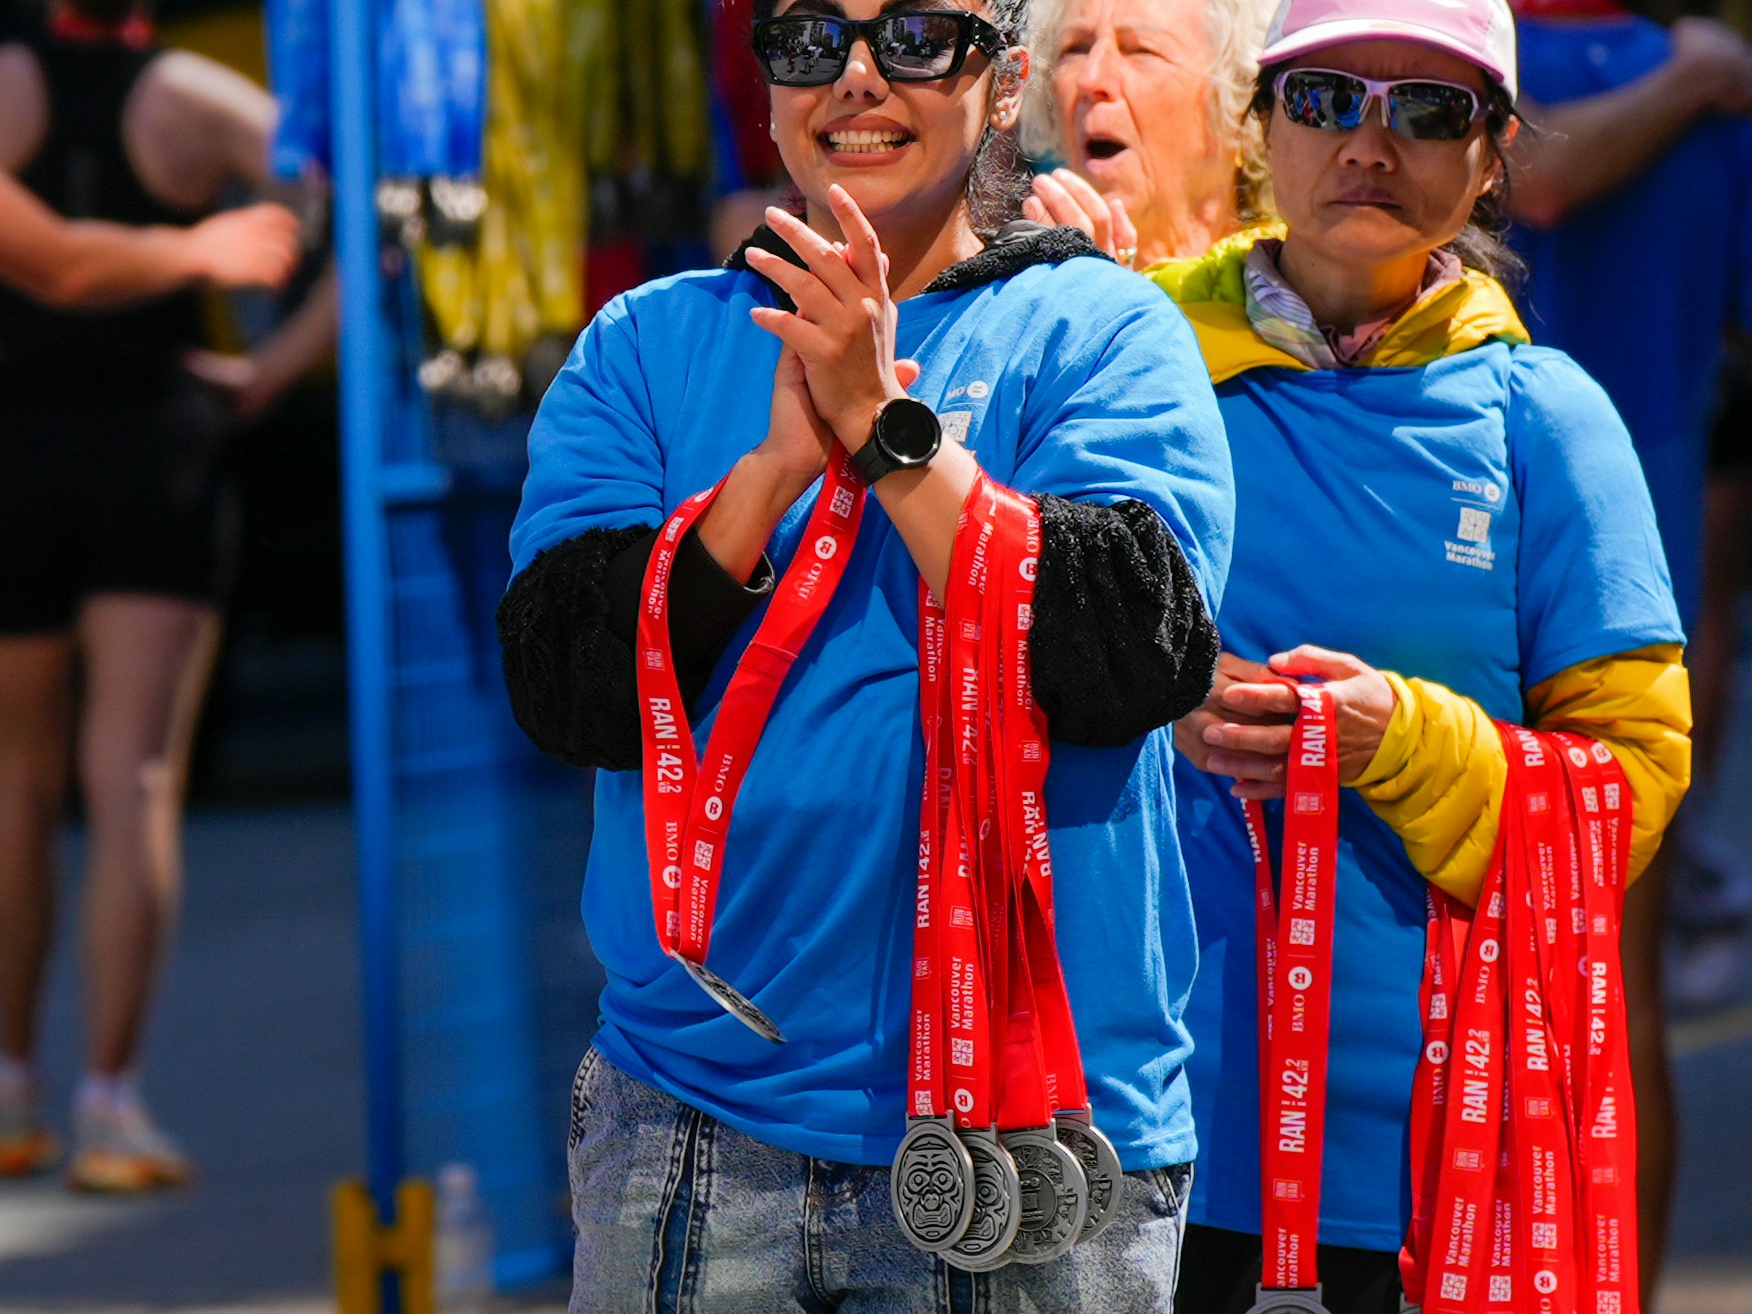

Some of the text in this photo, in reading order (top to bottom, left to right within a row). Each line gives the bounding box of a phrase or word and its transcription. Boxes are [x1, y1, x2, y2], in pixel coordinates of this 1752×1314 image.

[798, 563, 823, 600] BMO
[925, 616, 936, 683] Marathon
[649, 697, 678, 739] RAN
[1301, 725, 1326, 766] RAN
[714, 754, 733, 793] BMO
[665, 822, 677, 861] BMO
[917, 886, 930, 929] RAN
[1293, 841, 1306, 910] Vancouver
[1305, 847, 1319, 911] Marathon
[690, 875, 700, 941] Marathon
[696, 879, 709, 948] Vancouver
[951, 957, 962, 1029] Vancouver
[962, 963, 974, 1030] Marathon
[1292, 994, 1305, 1032] BMO
[1475, 966, 1490, 1004] BMO
[1592, 962, 1606, 1005] RAN
[915, 1010, 923, 1081] Vancouver
[923, 1014, 931, 1080] Marathon
[1527, 1029, 1550, 1071] RAN
[1279, 1110, 1304, 1153] RAN
[1461, 1080, 1488, 1124] RAN
[1532, 1145, 1542, 1215] Vancouver
[1545, 1151, 1556, 1215] Marathon
[1277, 1227, 1287, 1288] ancouver
[1289, 1233, 1299, 1288] arathon
[1445, 1197, 1465, 1267] Vancouver
[1458, 1204, 1477, 1268] Marathon
[1491, 1199, 1502, 1268] Vancouver
[1501, 1203, 1512, 1267] Marathon
[1597, 1214, 1606, 1283] Vancouver
[1608, 1218, 1619, 1283] Marathon
